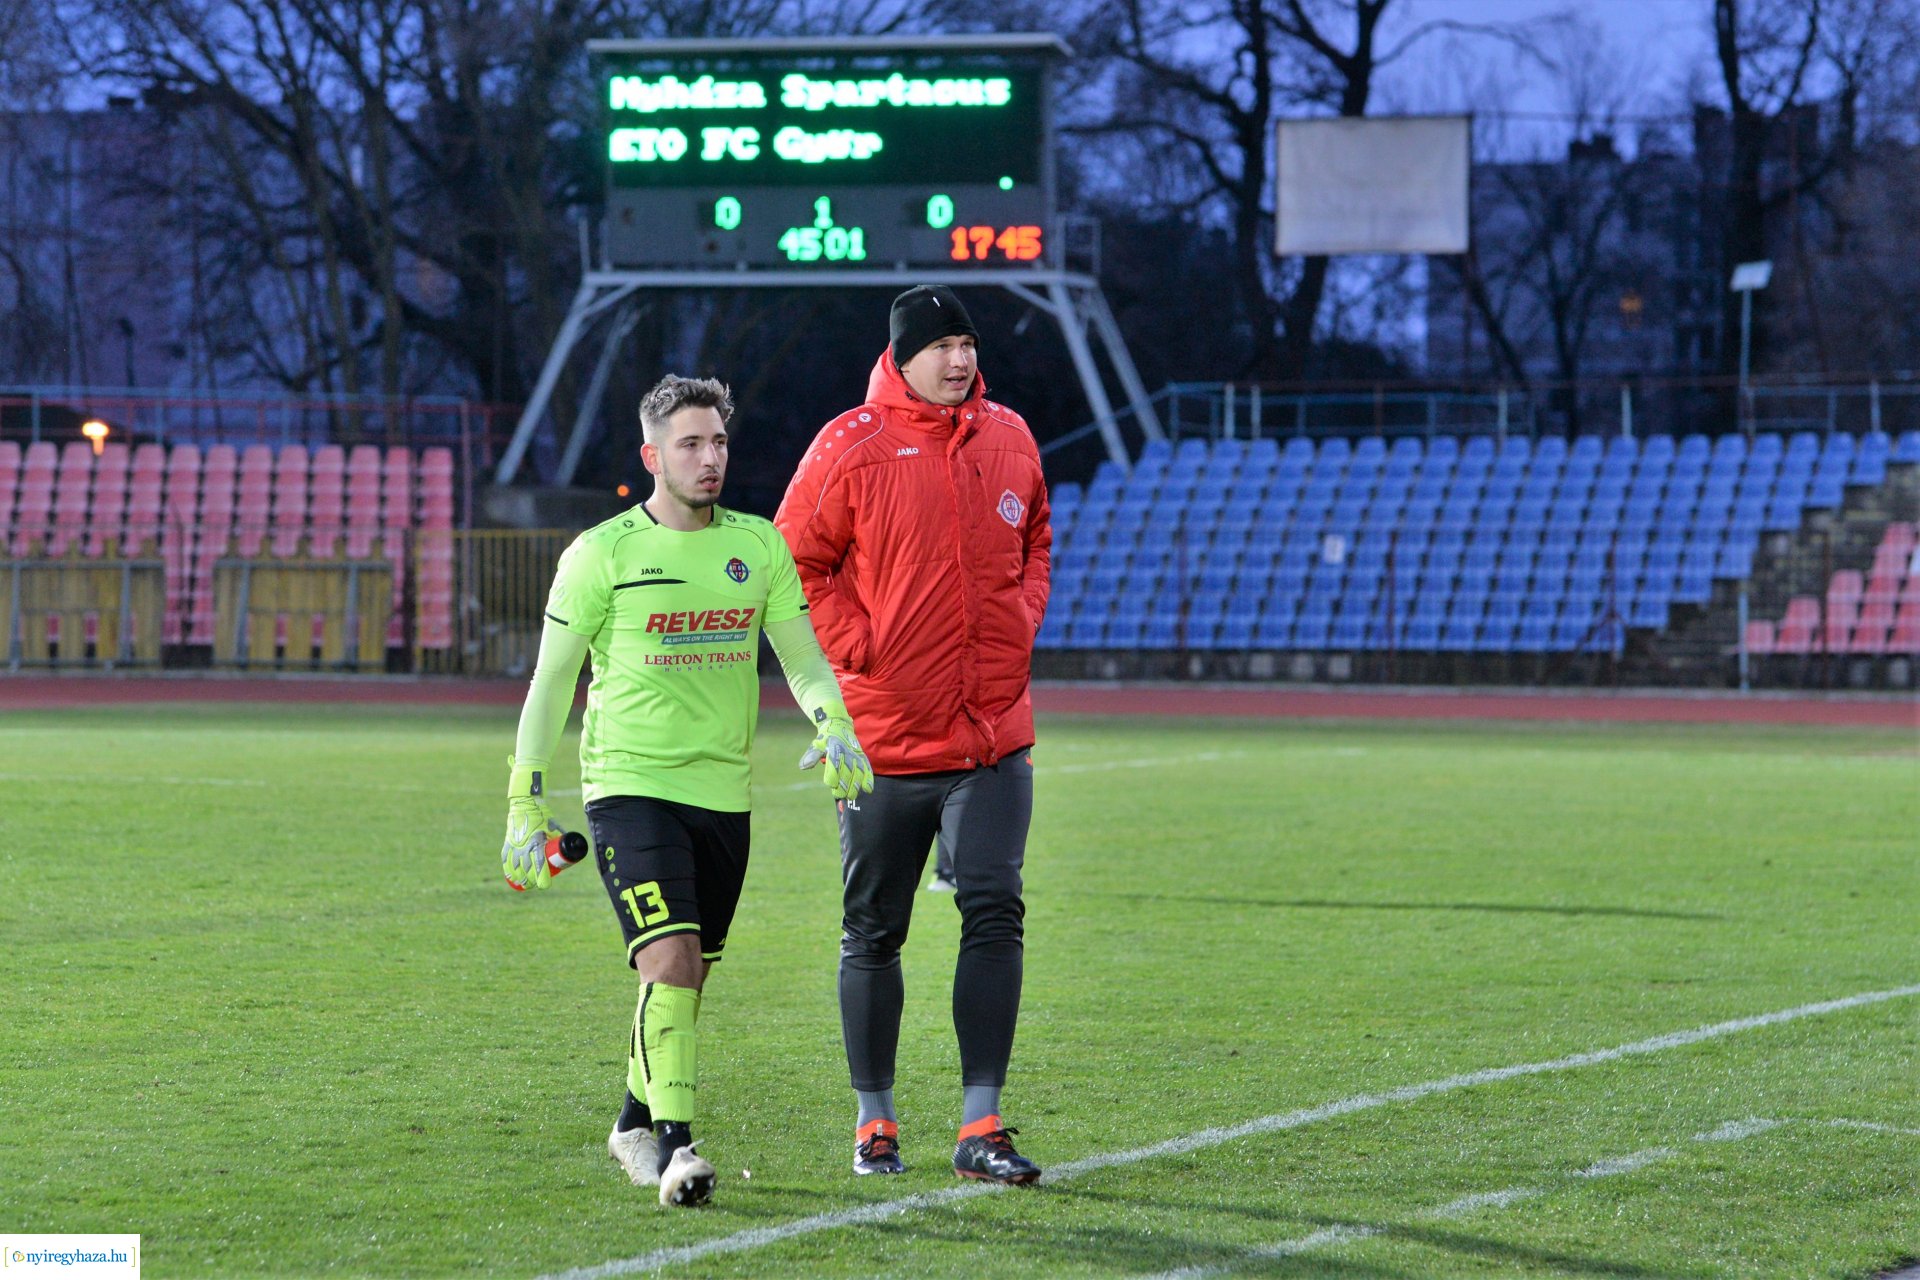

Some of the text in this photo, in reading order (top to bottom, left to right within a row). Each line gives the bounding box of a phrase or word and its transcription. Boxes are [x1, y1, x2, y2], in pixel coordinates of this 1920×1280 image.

[780, 72, 1012, 111] Spartacus
[609, 126, 688, 162] ETO
[700, 126, 760, 161] FC
[715, 196, 741, 230] 0
[814, 196, 833, 229] 1
[927, 194, 953, 229] 0
[896, 447, 919, 456] JAKO
[640, 568, 663, 576] JAKO
[645, 608, 756, 634] REVESZ
[664, 635, 690, 644] ALWAYS
[714, 632, 733, 641] RIGHT
[734, 632, 747, 640] WAY
[644, 650, 752, 666] LERTON TRANS
[664, 664, 734, 672] HUNGARY
[621, 880, 670, 928] 13
[664, 1081, 696, 1092] JAKO
